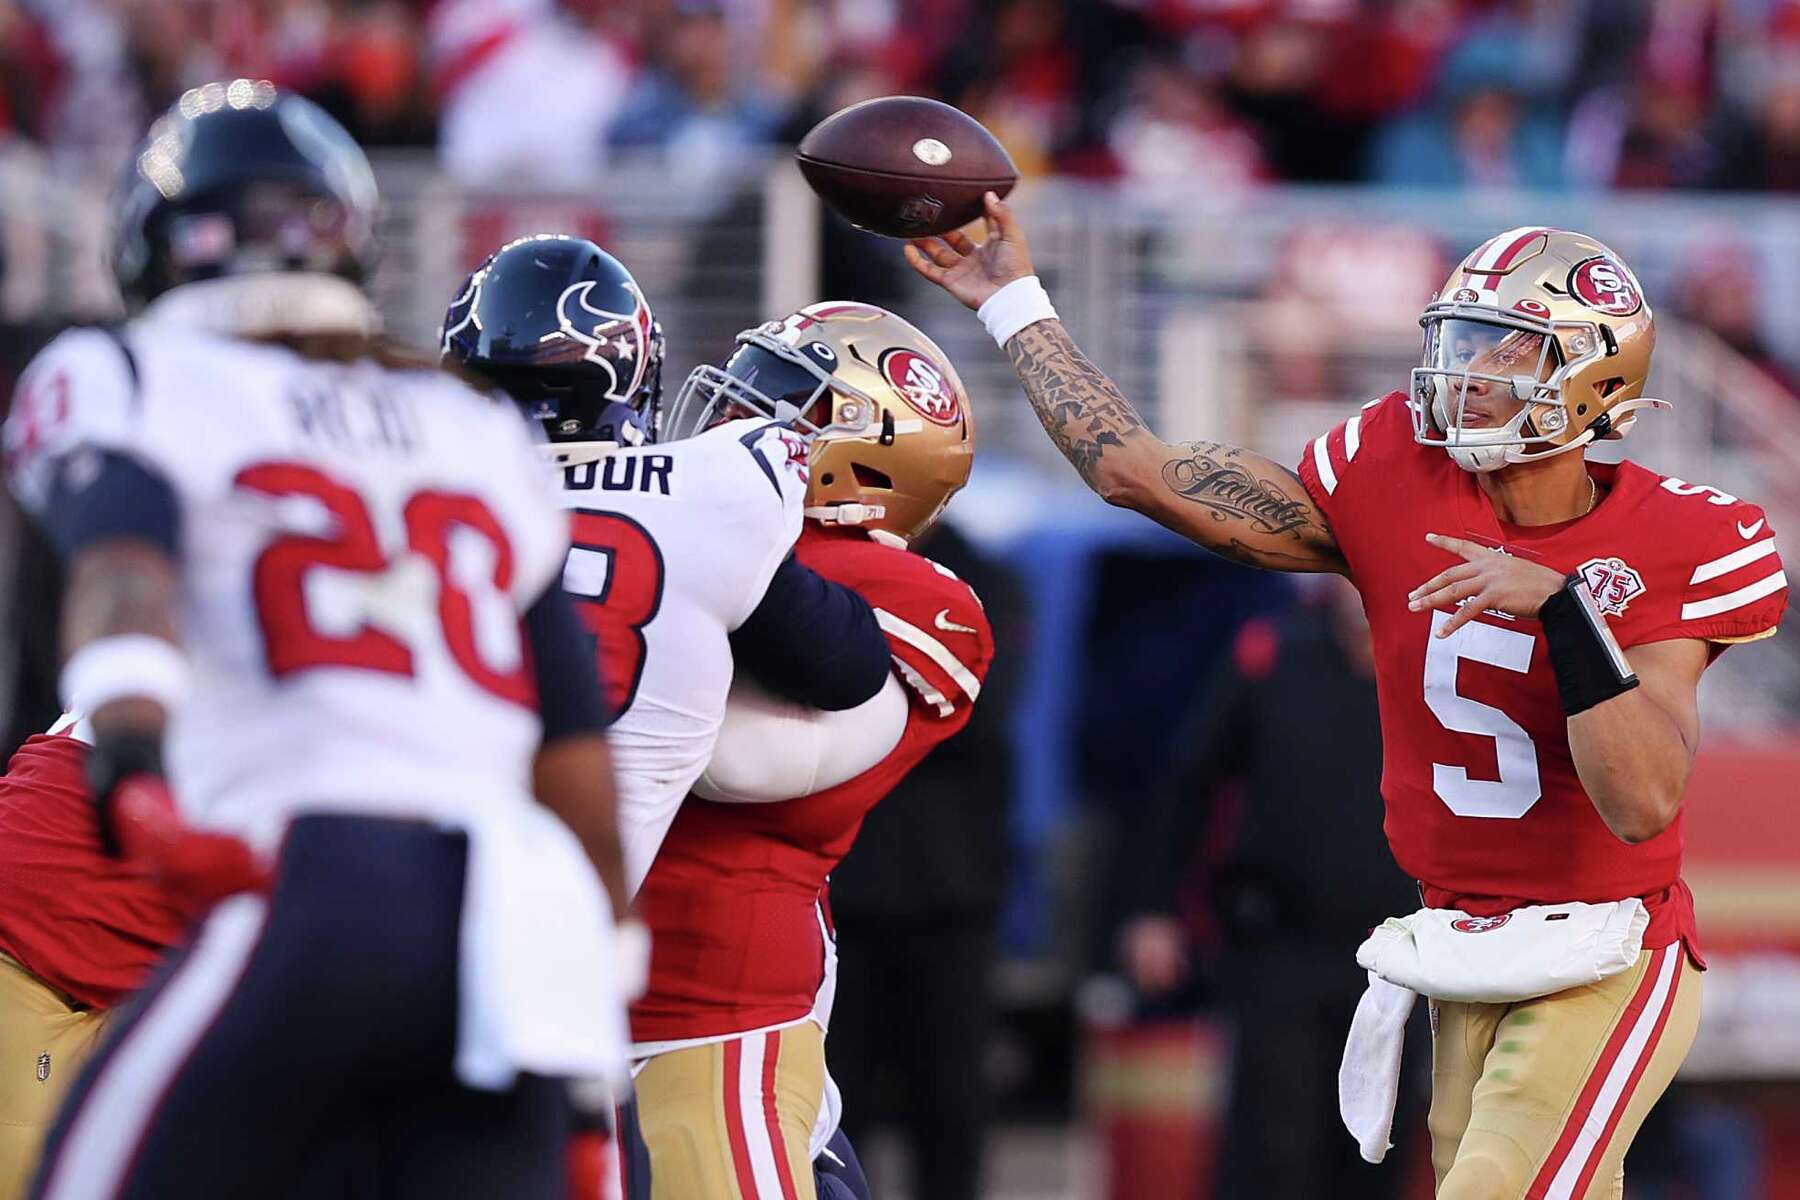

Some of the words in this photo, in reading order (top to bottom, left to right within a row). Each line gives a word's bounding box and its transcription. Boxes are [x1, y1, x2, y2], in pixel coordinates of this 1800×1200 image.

[230, 456, 541, 715] 20
[1589, 567, 1629, 603] 75
[1423, 609, 1541, 819] 5
